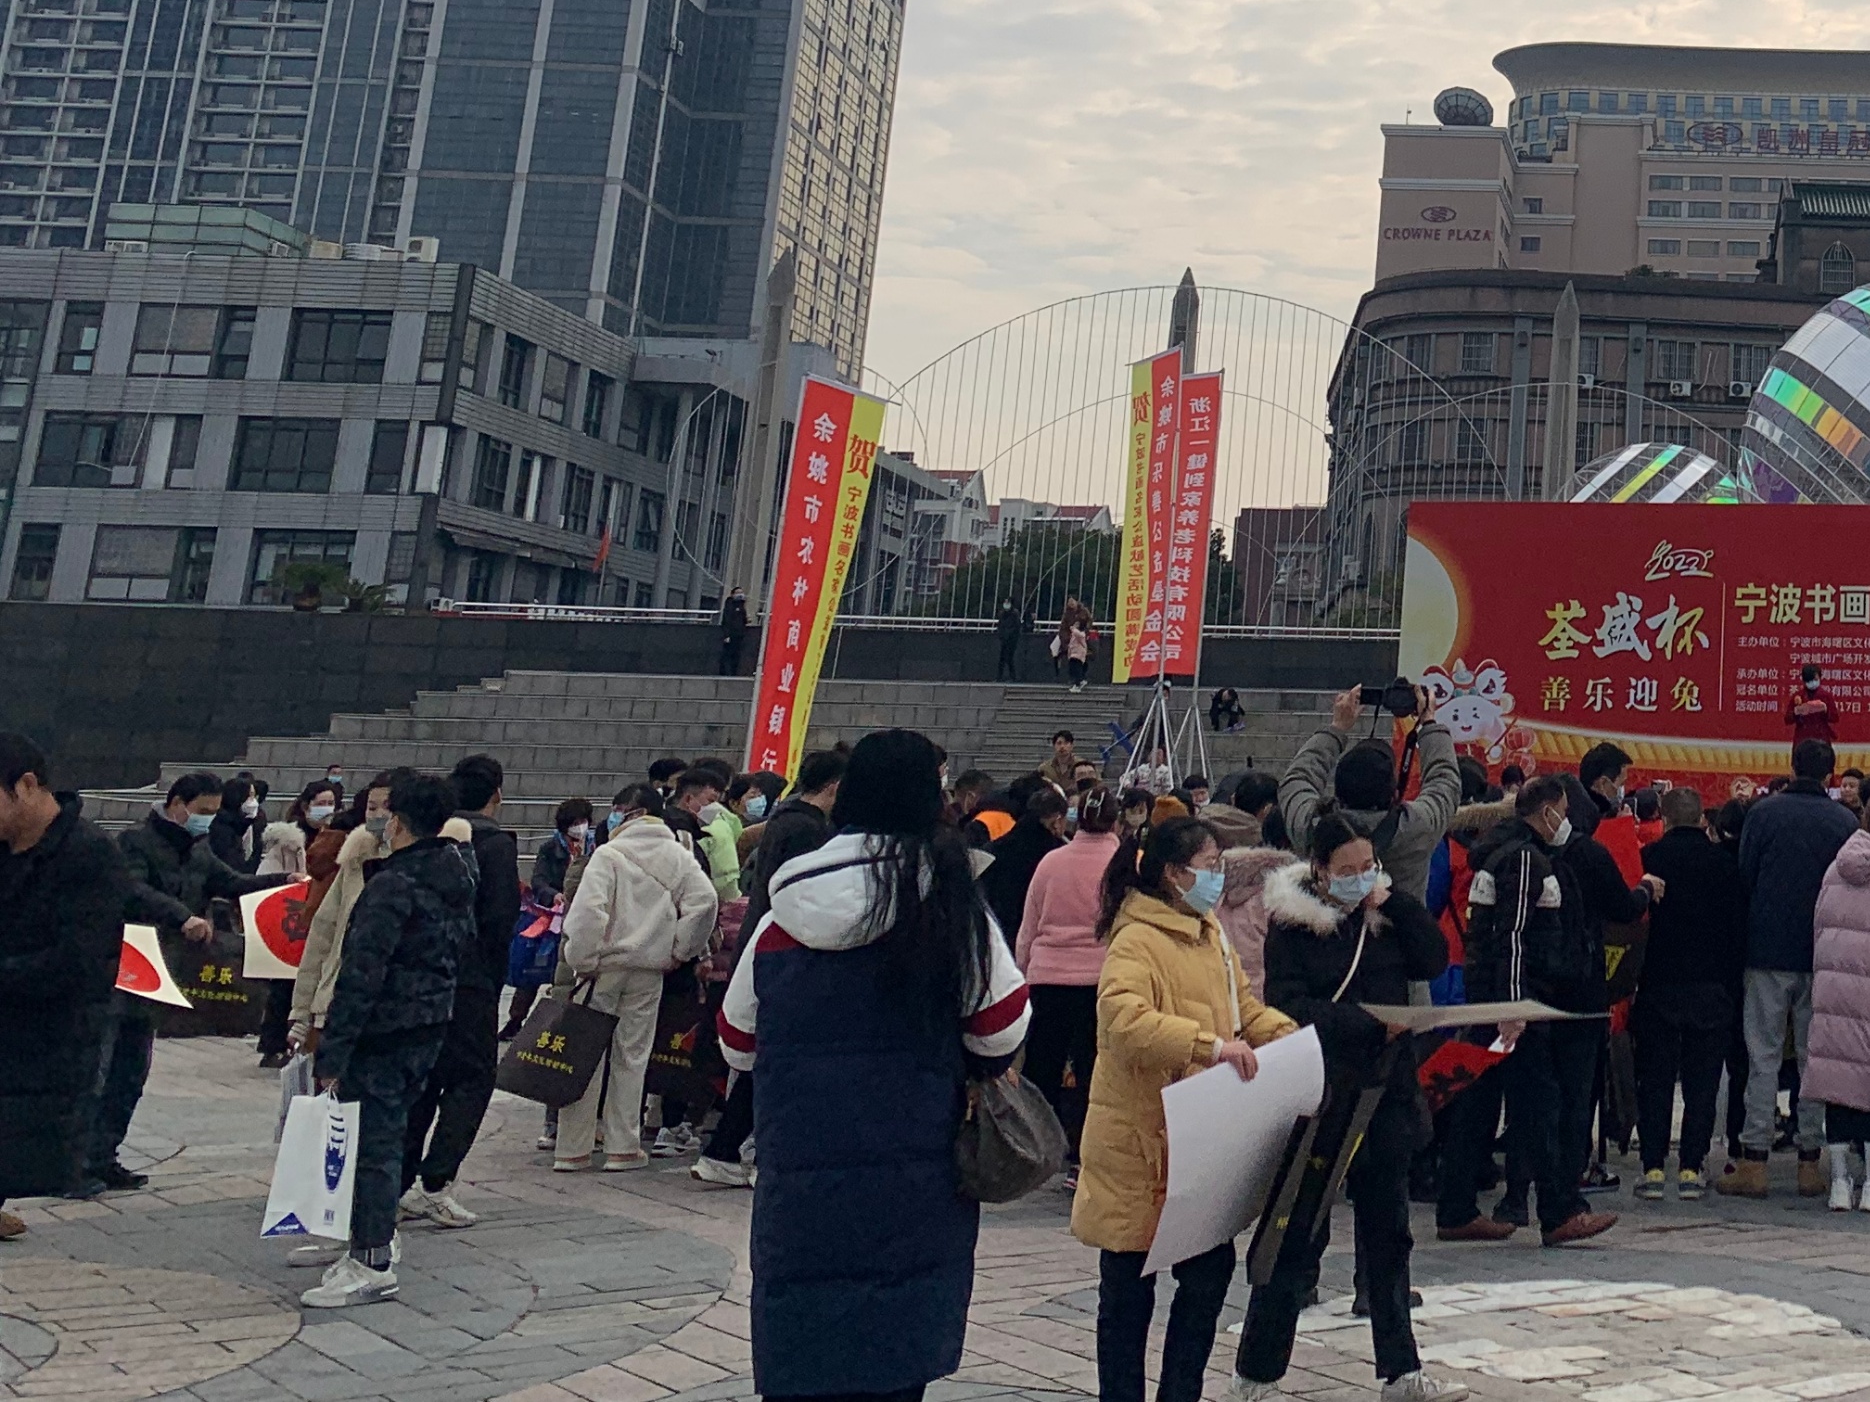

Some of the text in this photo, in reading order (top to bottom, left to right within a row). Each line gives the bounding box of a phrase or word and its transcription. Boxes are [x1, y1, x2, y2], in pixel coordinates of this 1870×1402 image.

[1383, 227, 1492, 242] CROWNE PLAZA
[846, 434, 877, 480] 贺
[1541, 676, 1702, 712] 善乐迎兔
